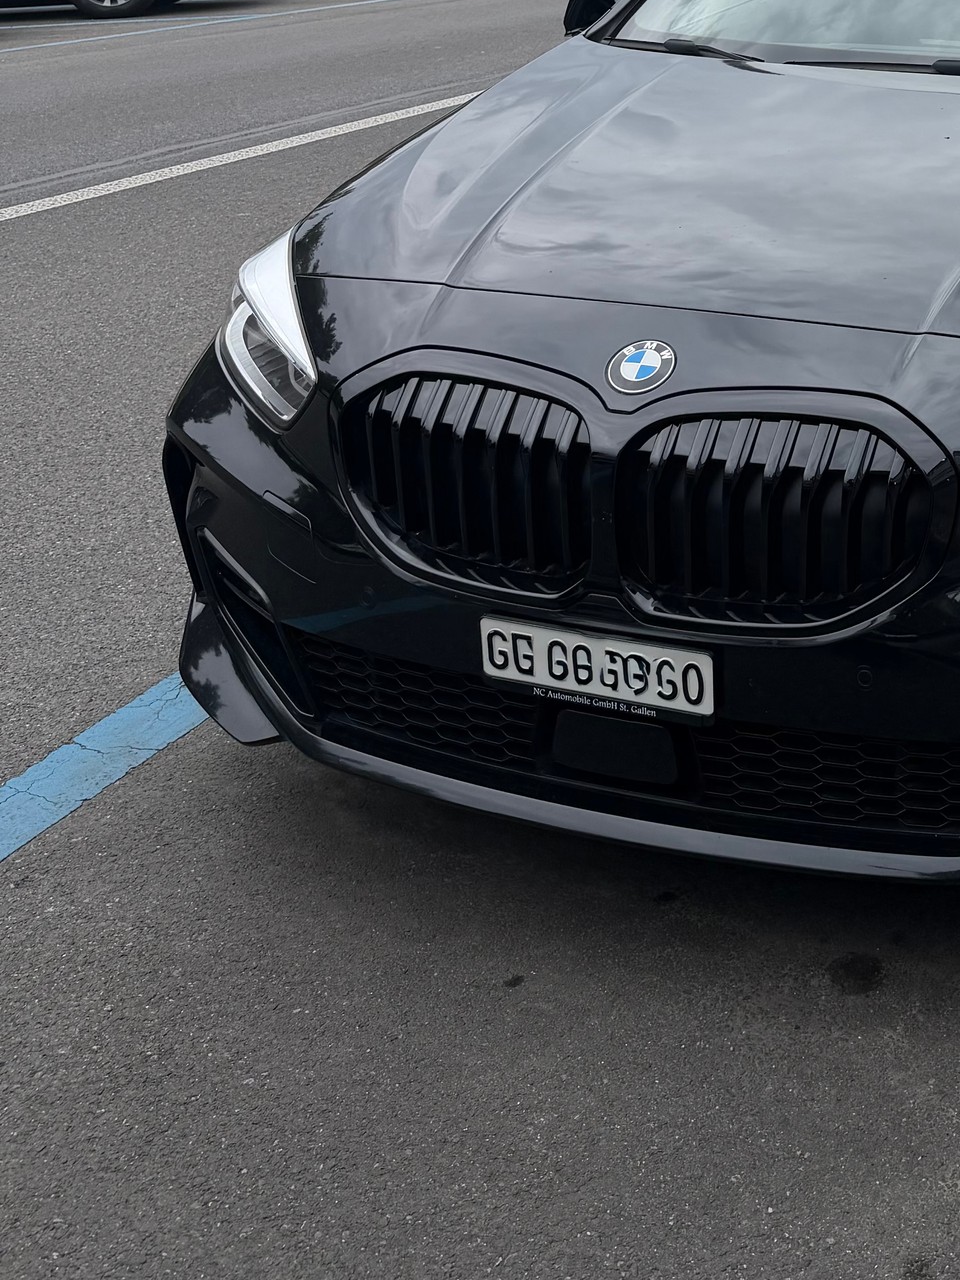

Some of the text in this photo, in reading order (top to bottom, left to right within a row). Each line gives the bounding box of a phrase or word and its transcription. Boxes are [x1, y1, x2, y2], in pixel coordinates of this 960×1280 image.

[623, 341, 672, 360] BMW
[533, 687, 657, 717] NC Automobile GmbH St. Gallen
